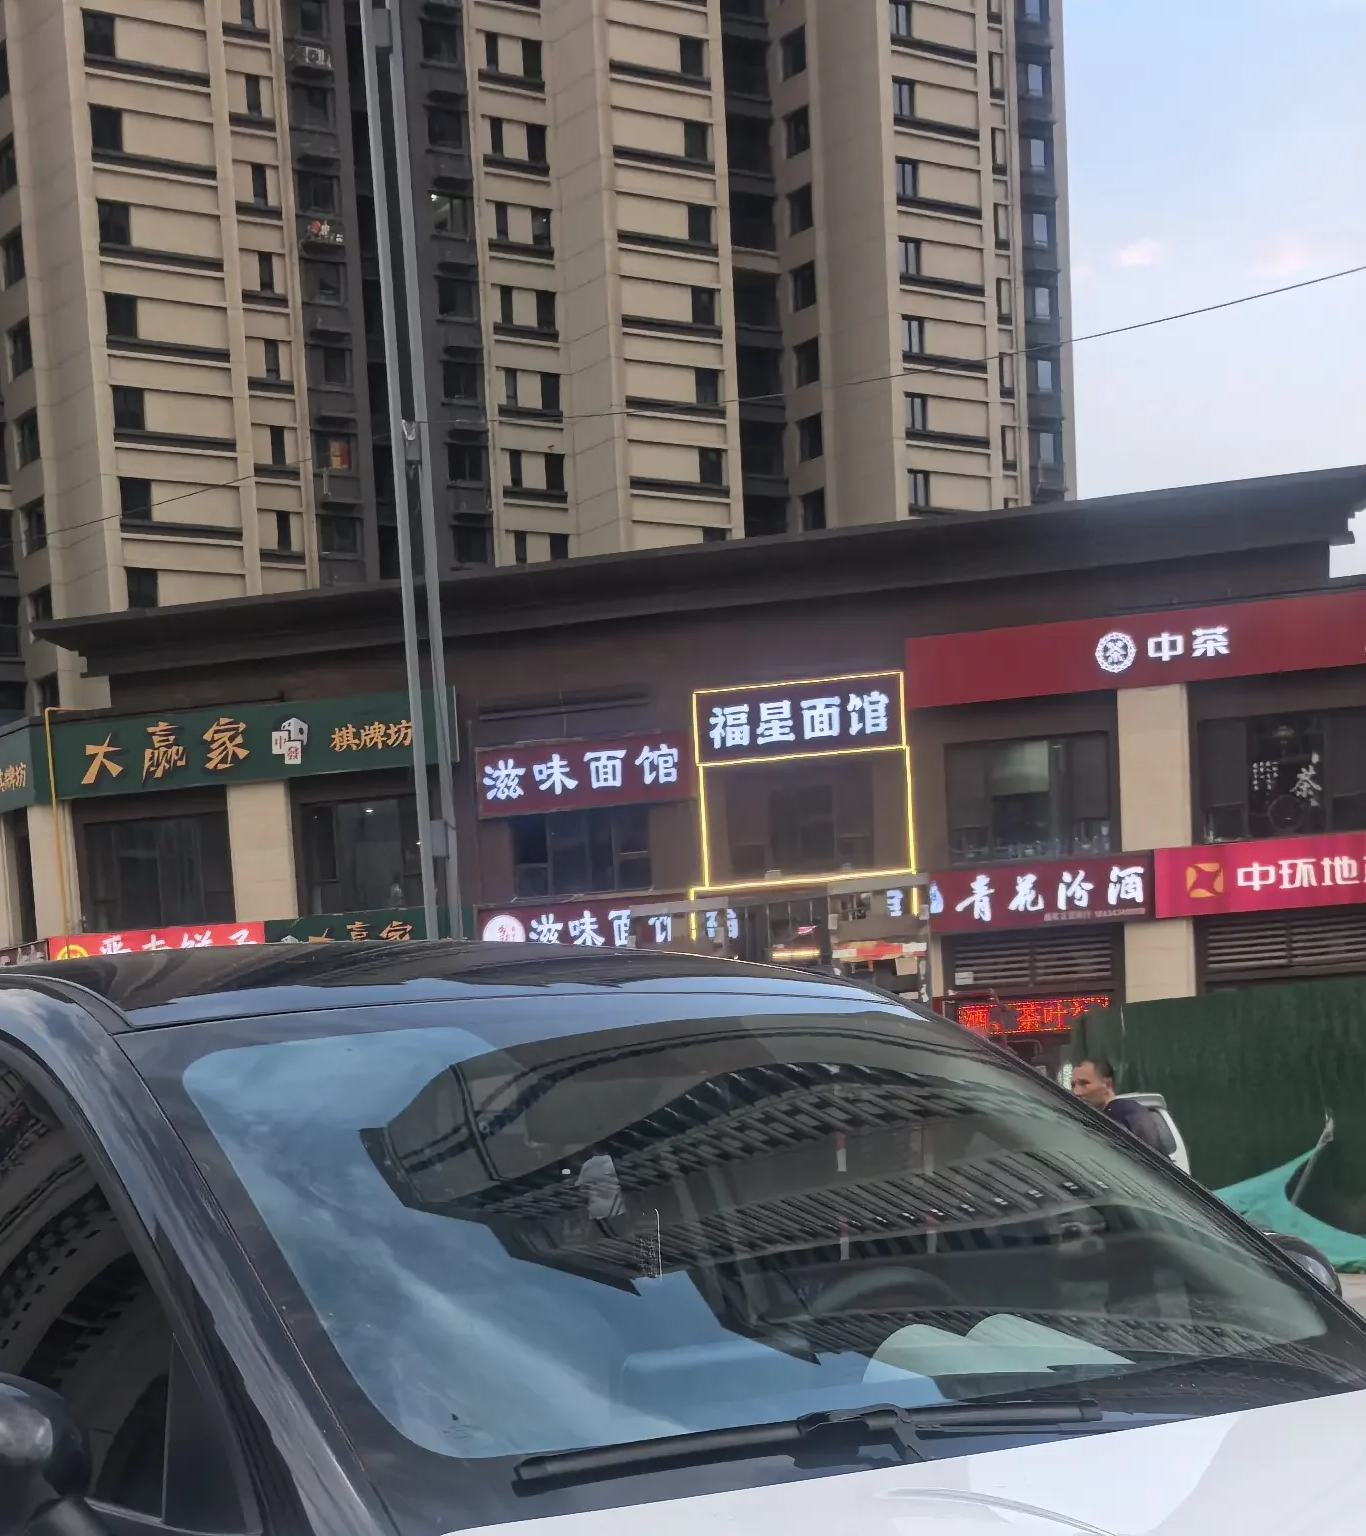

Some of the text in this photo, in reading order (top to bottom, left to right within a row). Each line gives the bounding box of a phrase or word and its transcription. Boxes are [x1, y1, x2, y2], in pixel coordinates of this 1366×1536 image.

[1147, 625, 1231, 662] 中茶
[709, 691, 890, 750] 福星面馆
[81, 717, 413, 785] 大赢家 棋牌坊
[483, 743, 679, 801] 滋味面馆
[955, 865, 1145, 922] 青花汾酒
